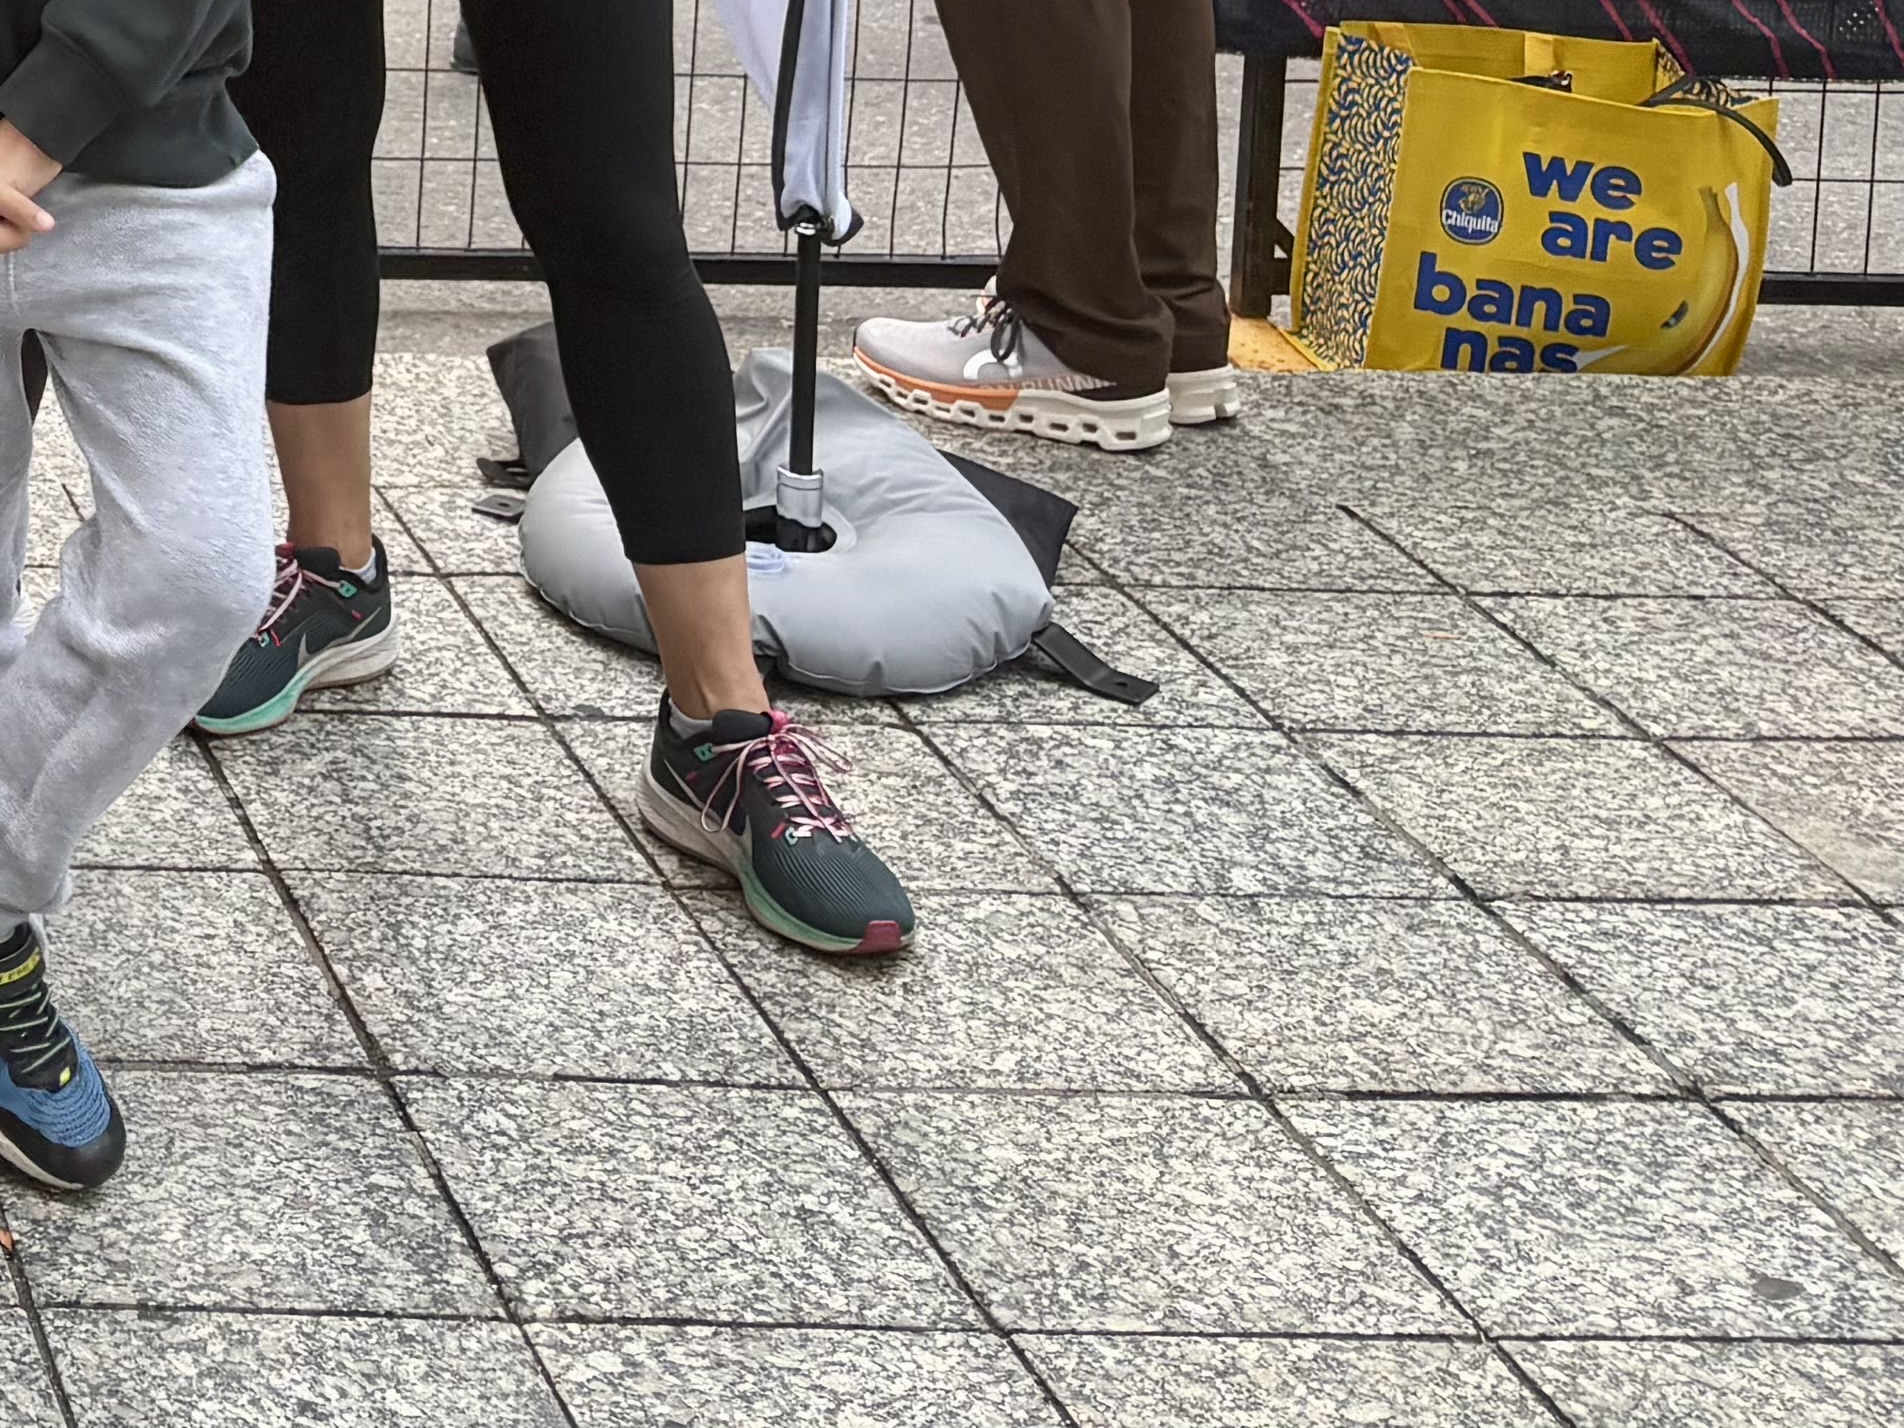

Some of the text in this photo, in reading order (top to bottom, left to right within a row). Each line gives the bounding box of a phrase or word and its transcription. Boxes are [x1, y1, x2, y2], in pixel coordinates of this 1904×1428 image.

[1522, 150, 1643, 211] we
[1441, 208, 1500, 235] Chiquita
[1540, 210, 1683, 271] are
[1413, 249, 1612, 338] bana
[1440, 326, 1582, 374] nas
